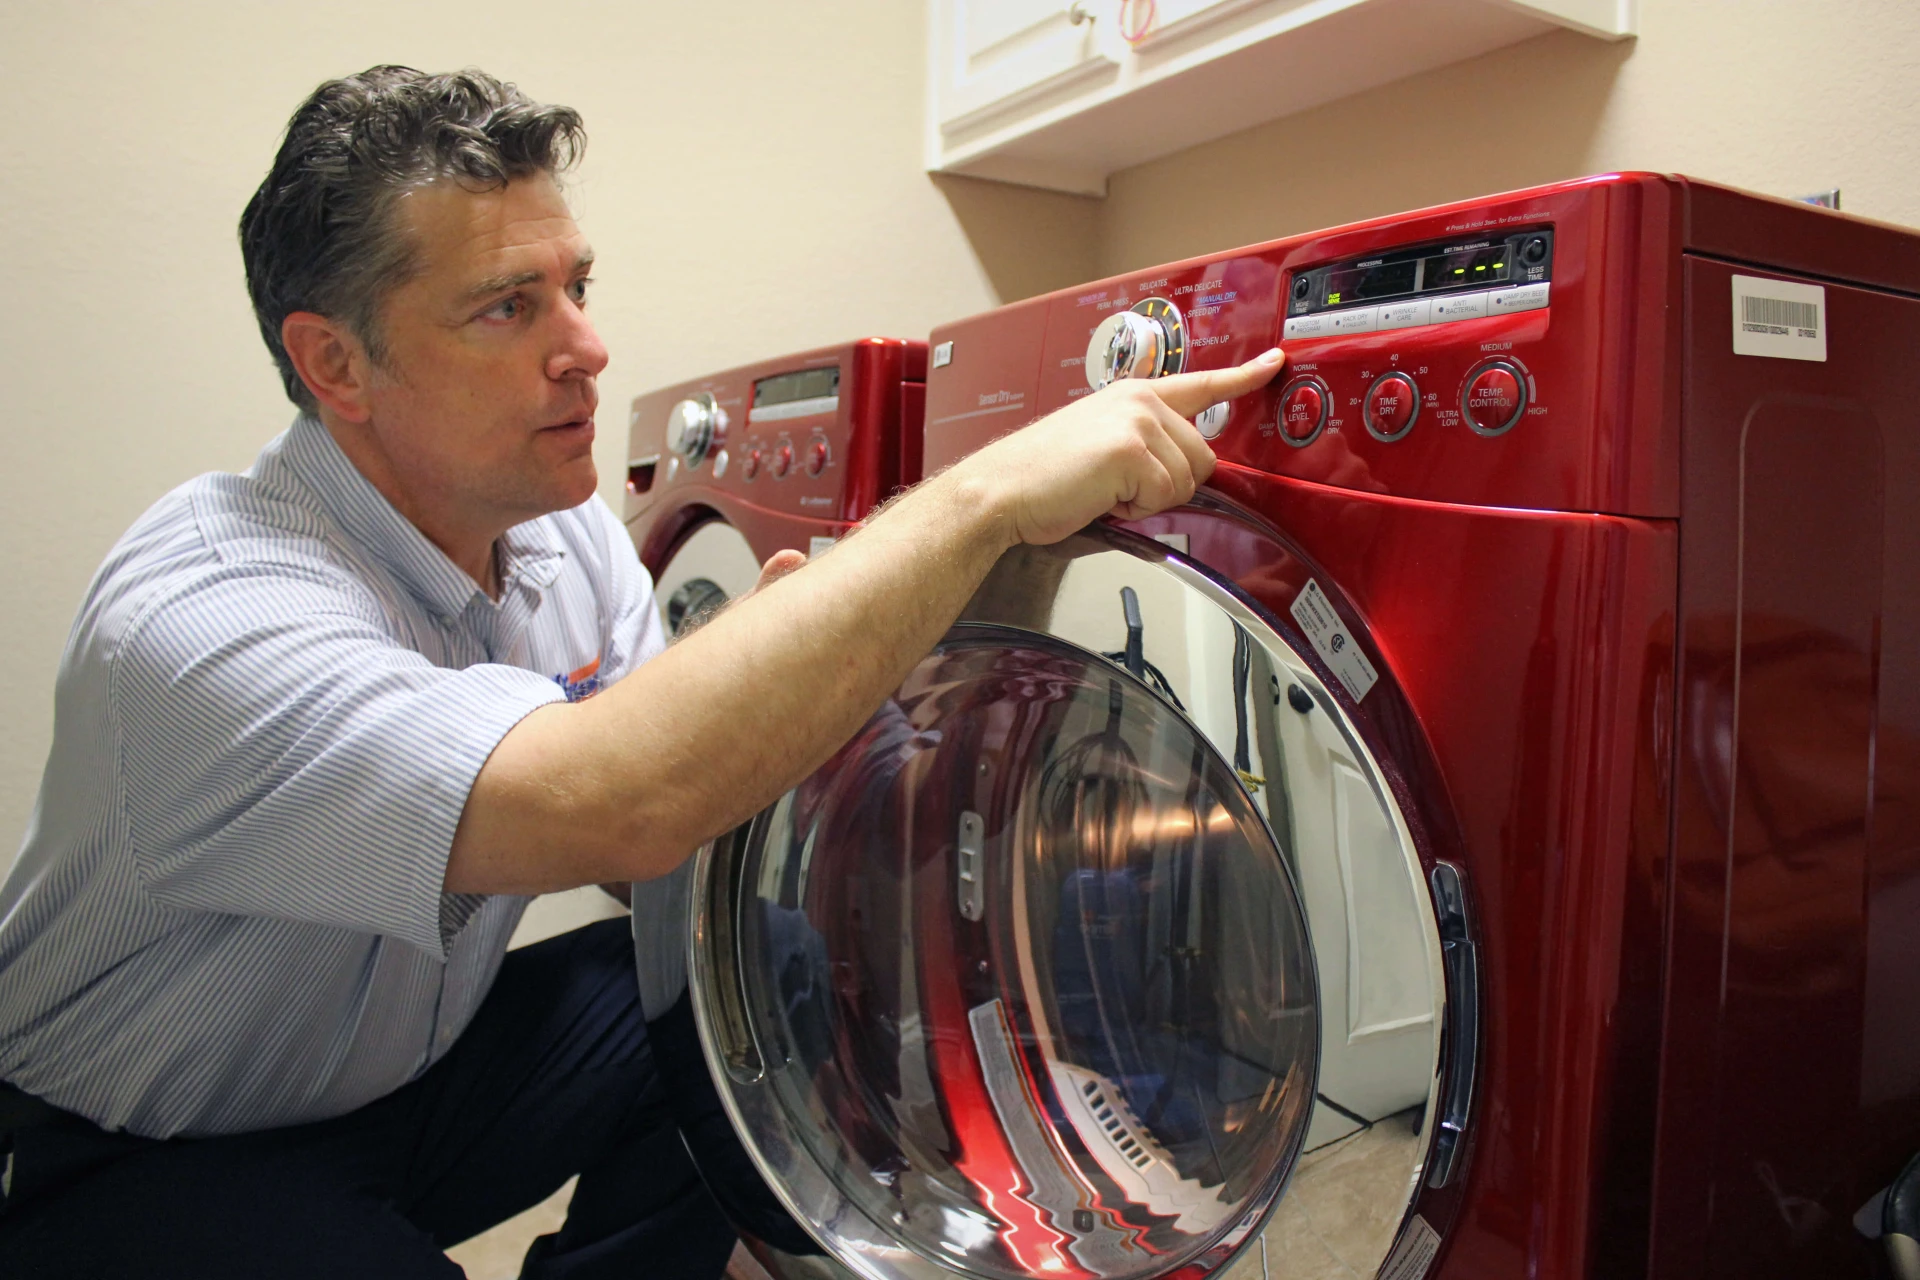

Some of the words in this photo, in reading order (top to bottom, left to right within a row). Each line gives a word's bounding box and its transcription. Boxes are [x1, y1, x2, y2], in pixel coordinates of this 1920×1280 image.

[1523, 212, 1550, 220] Functions
[1464, 242, 1489, 250] REMAINING
[1528, 266, 1544, 274] LESS
[1527, 273, 1543, 281] TIME
[1140, 278, 1168, 292] DELICATES
[1174, 285, 1193, 296] ULTRA
[1194, 280, 1222, 292] DELICATE
[1223, 291, 1237, 300] DRY
[1113, 297, 1129, 307] PRESS
[1187, 308, 1206, 318] SPEED
[1206, 305, 1221, 315] DRY
[1393, 307, 1418, 315] WRINKLE
[1446, 305, 1478, 315] BACTERIAL
[1297, 325, 1321, 333] PROGRAM
[1191, 337, 1219, 347] FRESHEN
[1220, 335, 1229, 344] UP
[1481, 342, 1512, 351] MEDIUM
[1293, 364, 1318, 372] NORMAL
[1478, 388, 1503, 397] TEMP.
[999, 390, 1010, 404] Dry
[1380, 397, 1398, 405] TIME
[1428, 393, 1437, 401] 60
[1470, 398, 1512, 407] CONTROL
[1292, 404, 1306, 412] DRY
[1380, 407, 1396, 415] DRY
[1288, 413, 1309, 422] LEVEL
[1437, 410, 1459, 418] ULTRA
[1327, 427, 1340, 435] DRY
